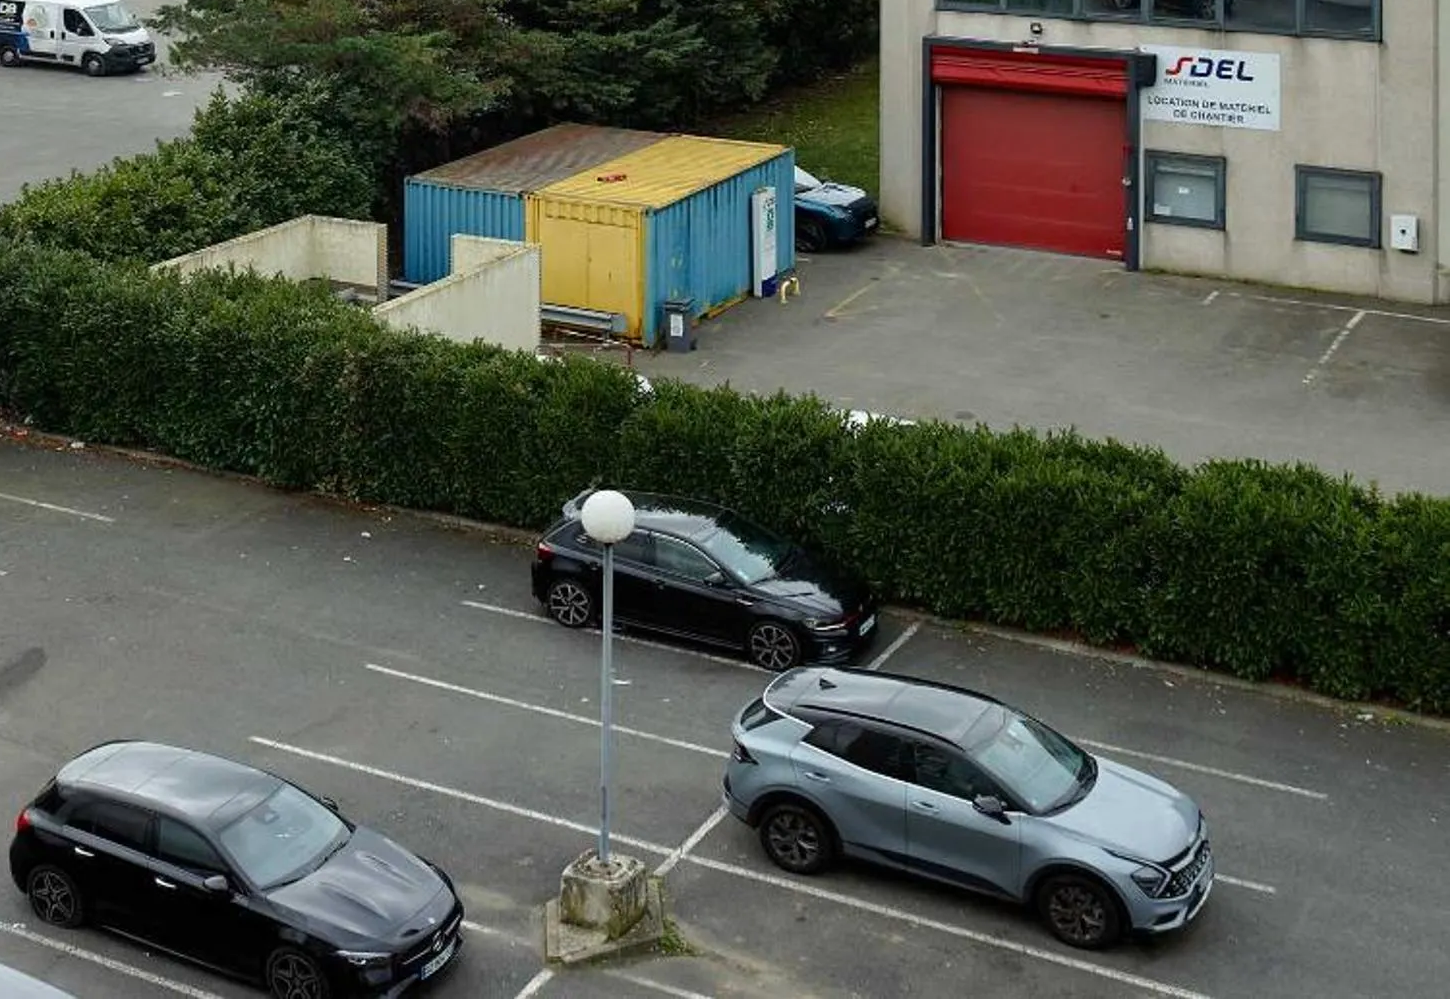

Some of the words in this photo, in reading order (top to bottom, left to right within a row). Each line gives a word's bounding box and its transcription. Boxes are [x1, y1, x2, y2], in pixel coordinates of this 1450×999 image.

[1165, 56, 1254, 82] SDEL
[1147, 95, 1200, 109] LOCATION
[1201, 101, 1217, 111] DE
[1172, 109, 1188, 119] DE
[1190, 110, 1245, 124] CHANTIER
